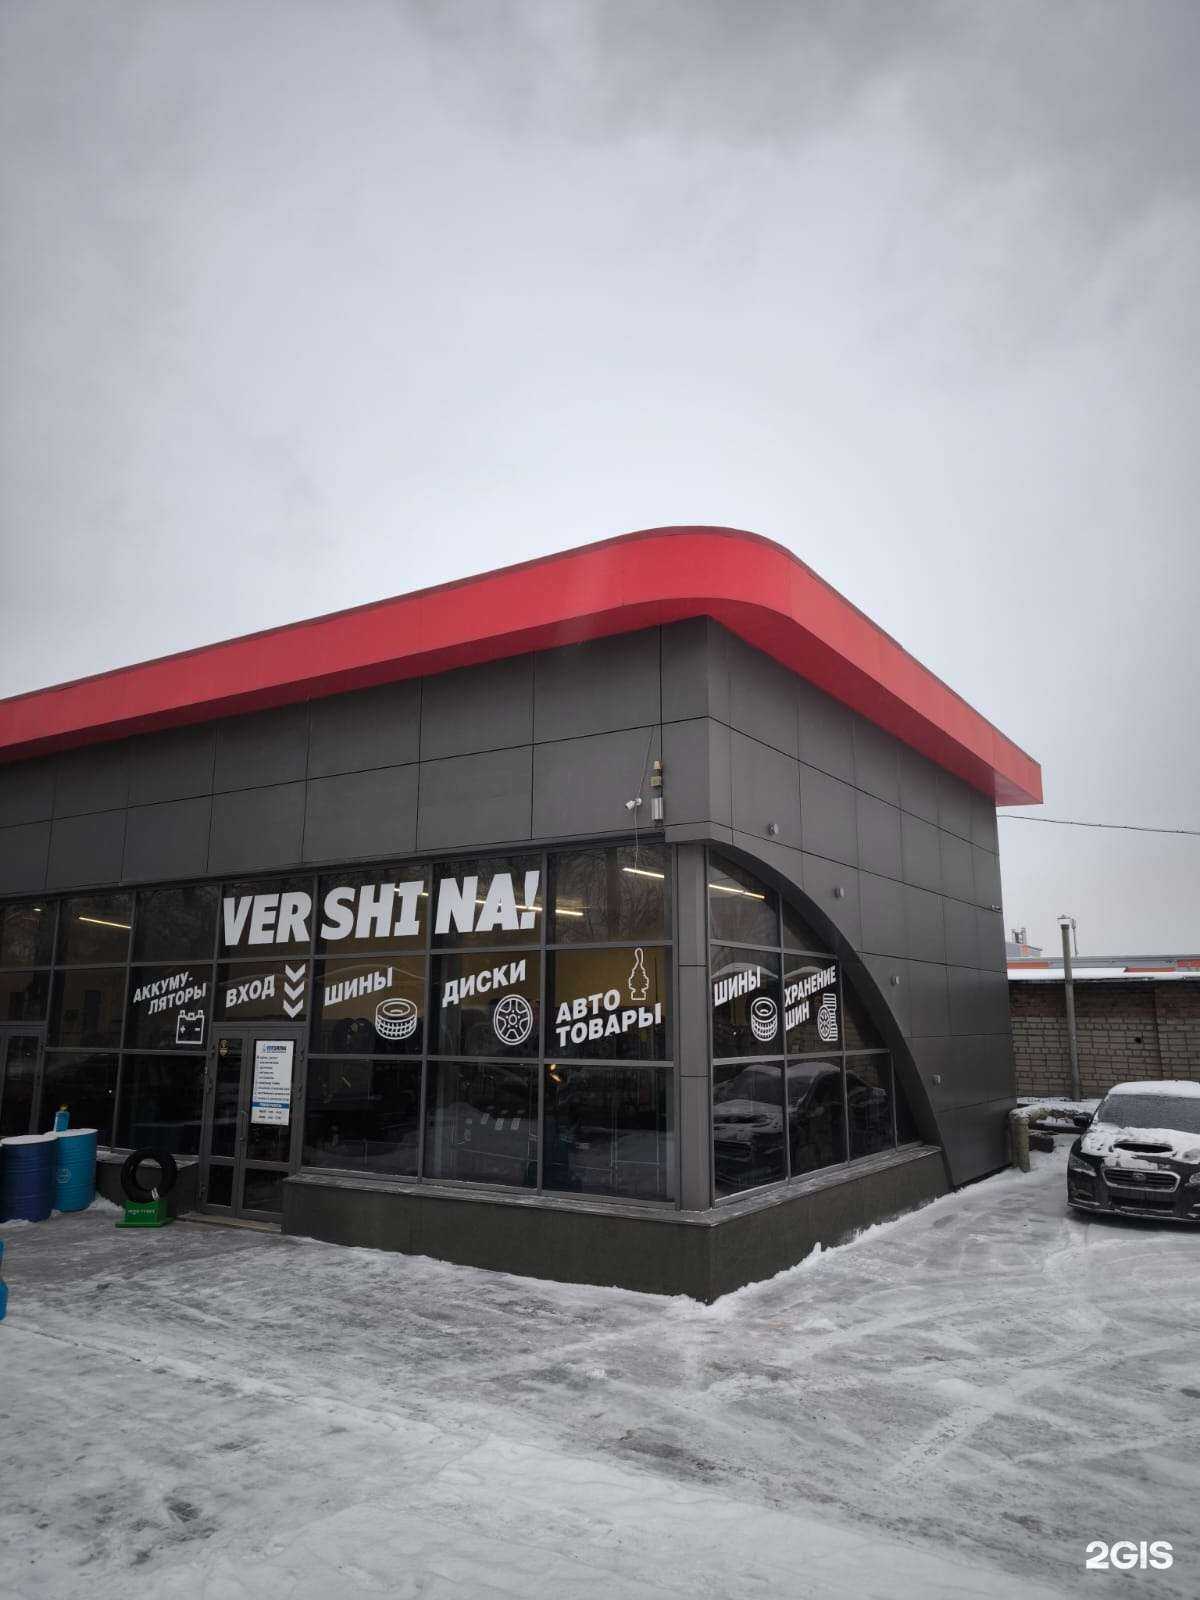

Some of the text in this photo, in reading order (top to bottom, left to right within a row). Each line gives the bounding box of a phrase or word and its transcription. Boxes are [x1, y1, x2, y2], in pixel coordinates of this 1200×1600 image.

[133, 971, 193, 1003] АККУМУ-
[148, 983, 207, 1015] ЛЯТОРЫ
[225, 975, 275, 1008] ВХОД
[324, 967, 393, 1007] ШИНЫ
[441, 960, 527, 1008] ДИСКИ
[713, 966, 761, 1006] ШИНЫ
[784, 964, 837, 1008] ХРАНЕНИЕ
[555, 989, 621, 1024] АВТО
[556, 1002, 662, 1047] ТОВАРЫ
[784, 1000, 810, 1032] ШИН
